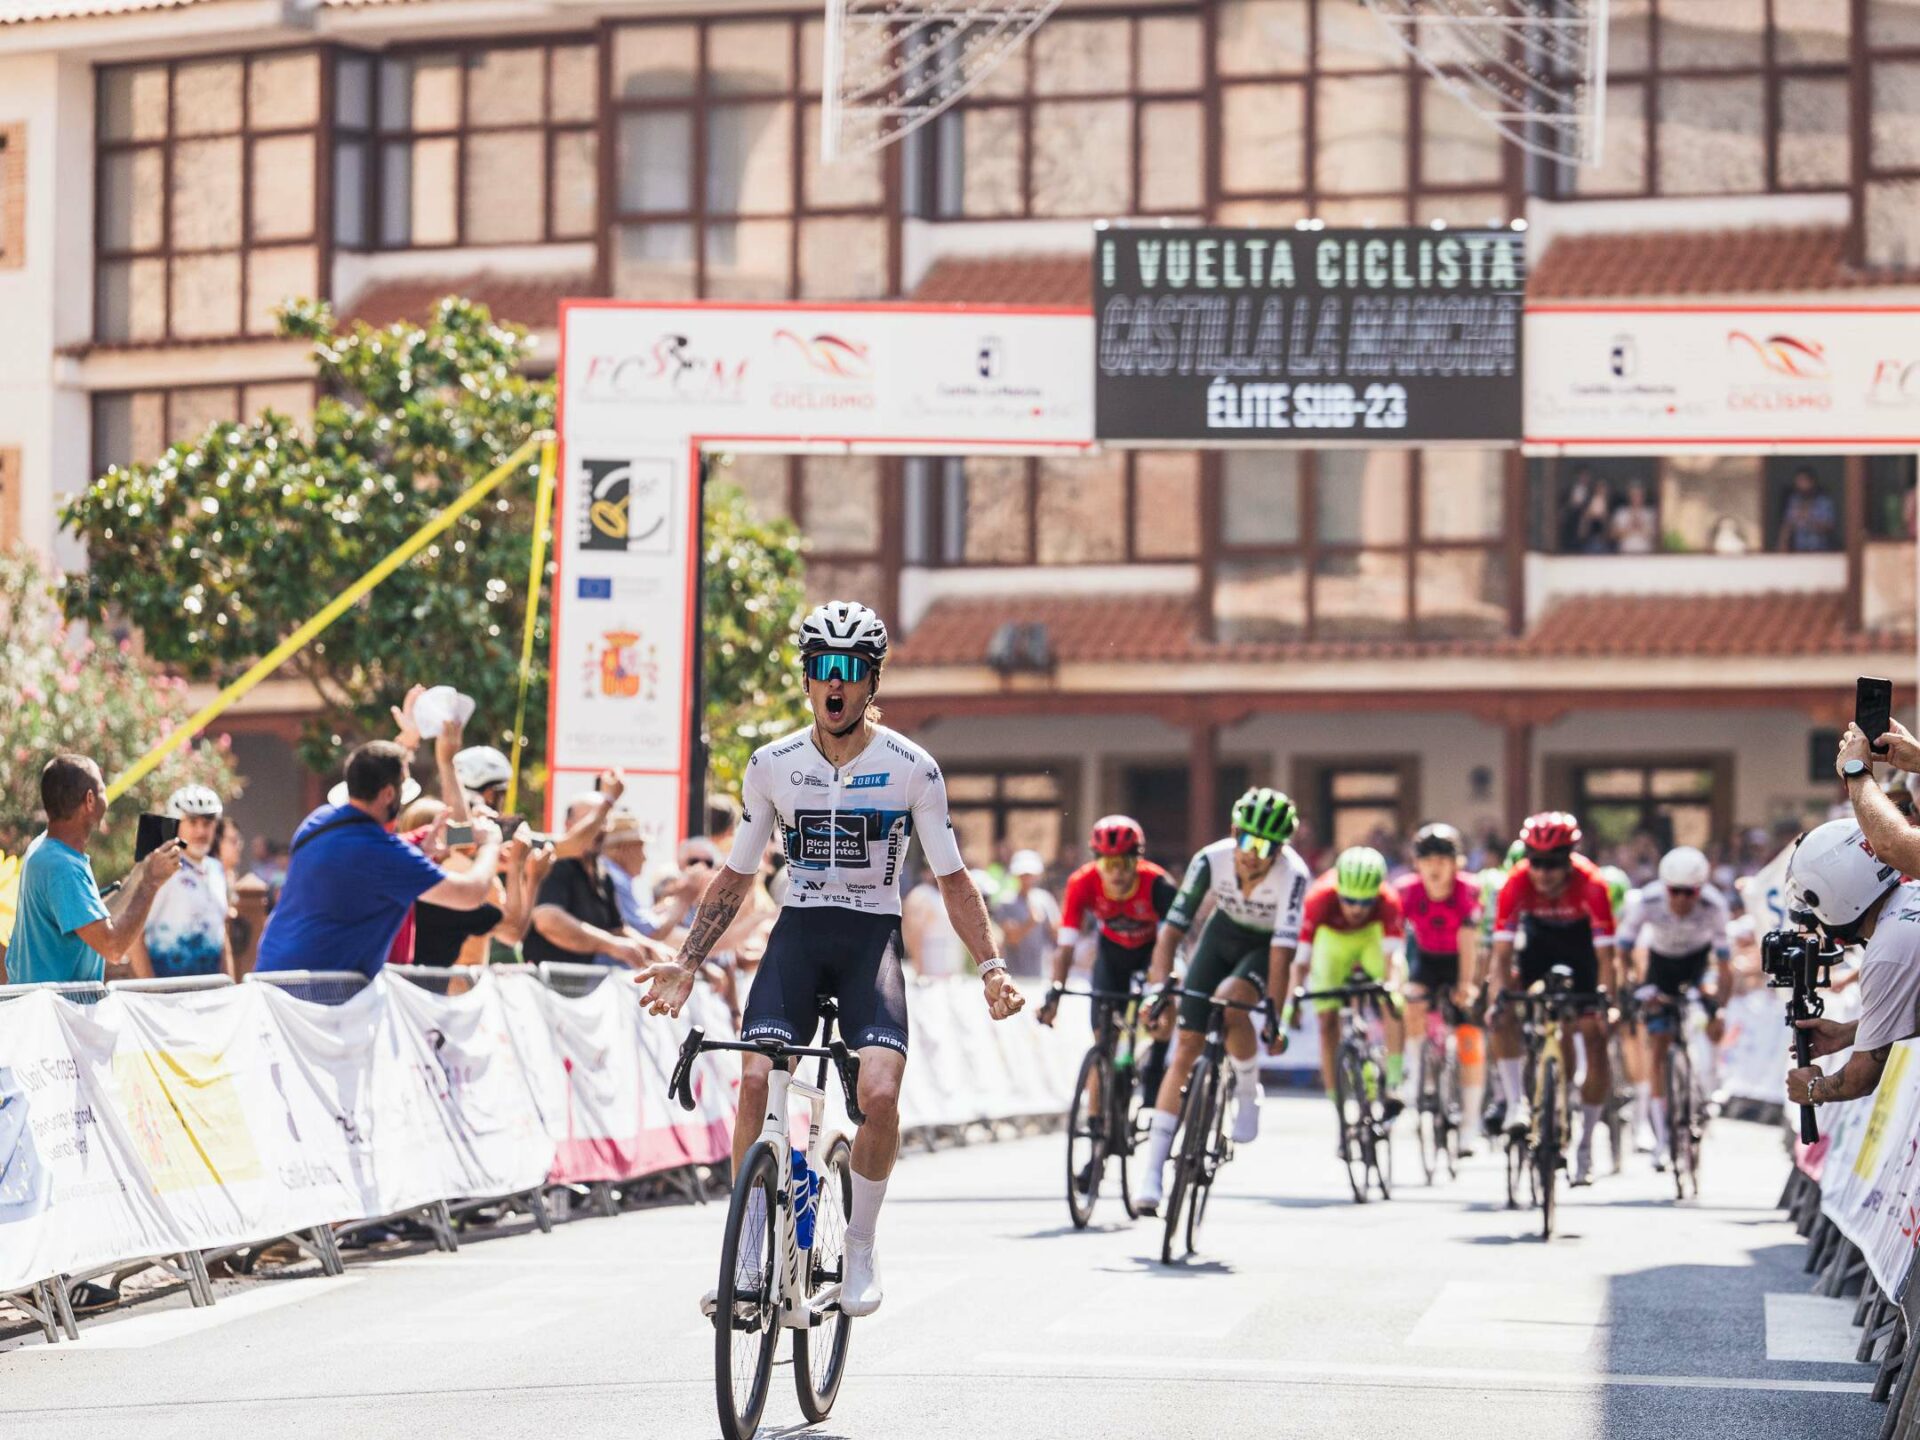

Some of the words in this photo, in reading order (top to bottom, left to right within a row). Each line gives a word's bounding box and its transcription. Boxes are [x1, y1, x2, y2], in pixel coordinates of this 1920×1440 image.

[1102, 239, 1116, 288] I
[1137, 239, 1296, 288] VUELTA
[1316, 239, 1518, 288] CICLISTA
[1100, 294, 1284, 376] CASTILLA
[1286, 295, 1342, 376] LA
[1206, 377, 1291, 429] ÉLITE
[1293, 383, 1408, 429] SUB-23
[772, 741, 805, 757] CANYON
[886, 740, 915, 763] CANYON
[806, 839, 859, 848] Ricardo
[806, 847, 861, 856] Fuentes
[883, 832, 898, 886] marmo
[749, 1026, 792, 1040] marmo
[877, 1036, 908, 1054] marm
